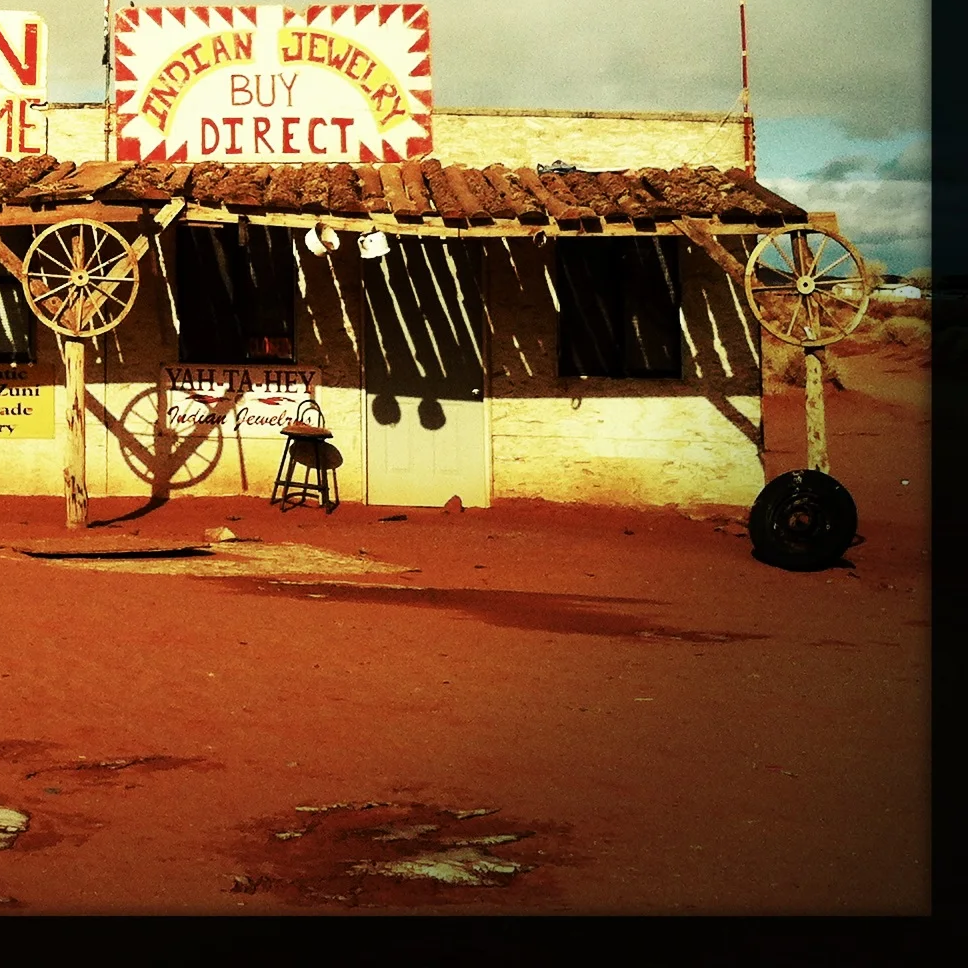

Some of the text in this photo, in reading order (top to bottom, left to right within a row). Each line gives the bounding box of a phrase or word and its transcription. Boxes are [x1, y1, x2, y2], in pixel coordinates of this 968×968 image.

[142, 31, 406, 132] INDIAN JEWELRY
[230, 73, 299, 107] BUY
[200, 117, 354, 155] DIRECT
[164, 367, 316, 394] YAH-TA-HEY
[167, 405, 228, 425] Indian
